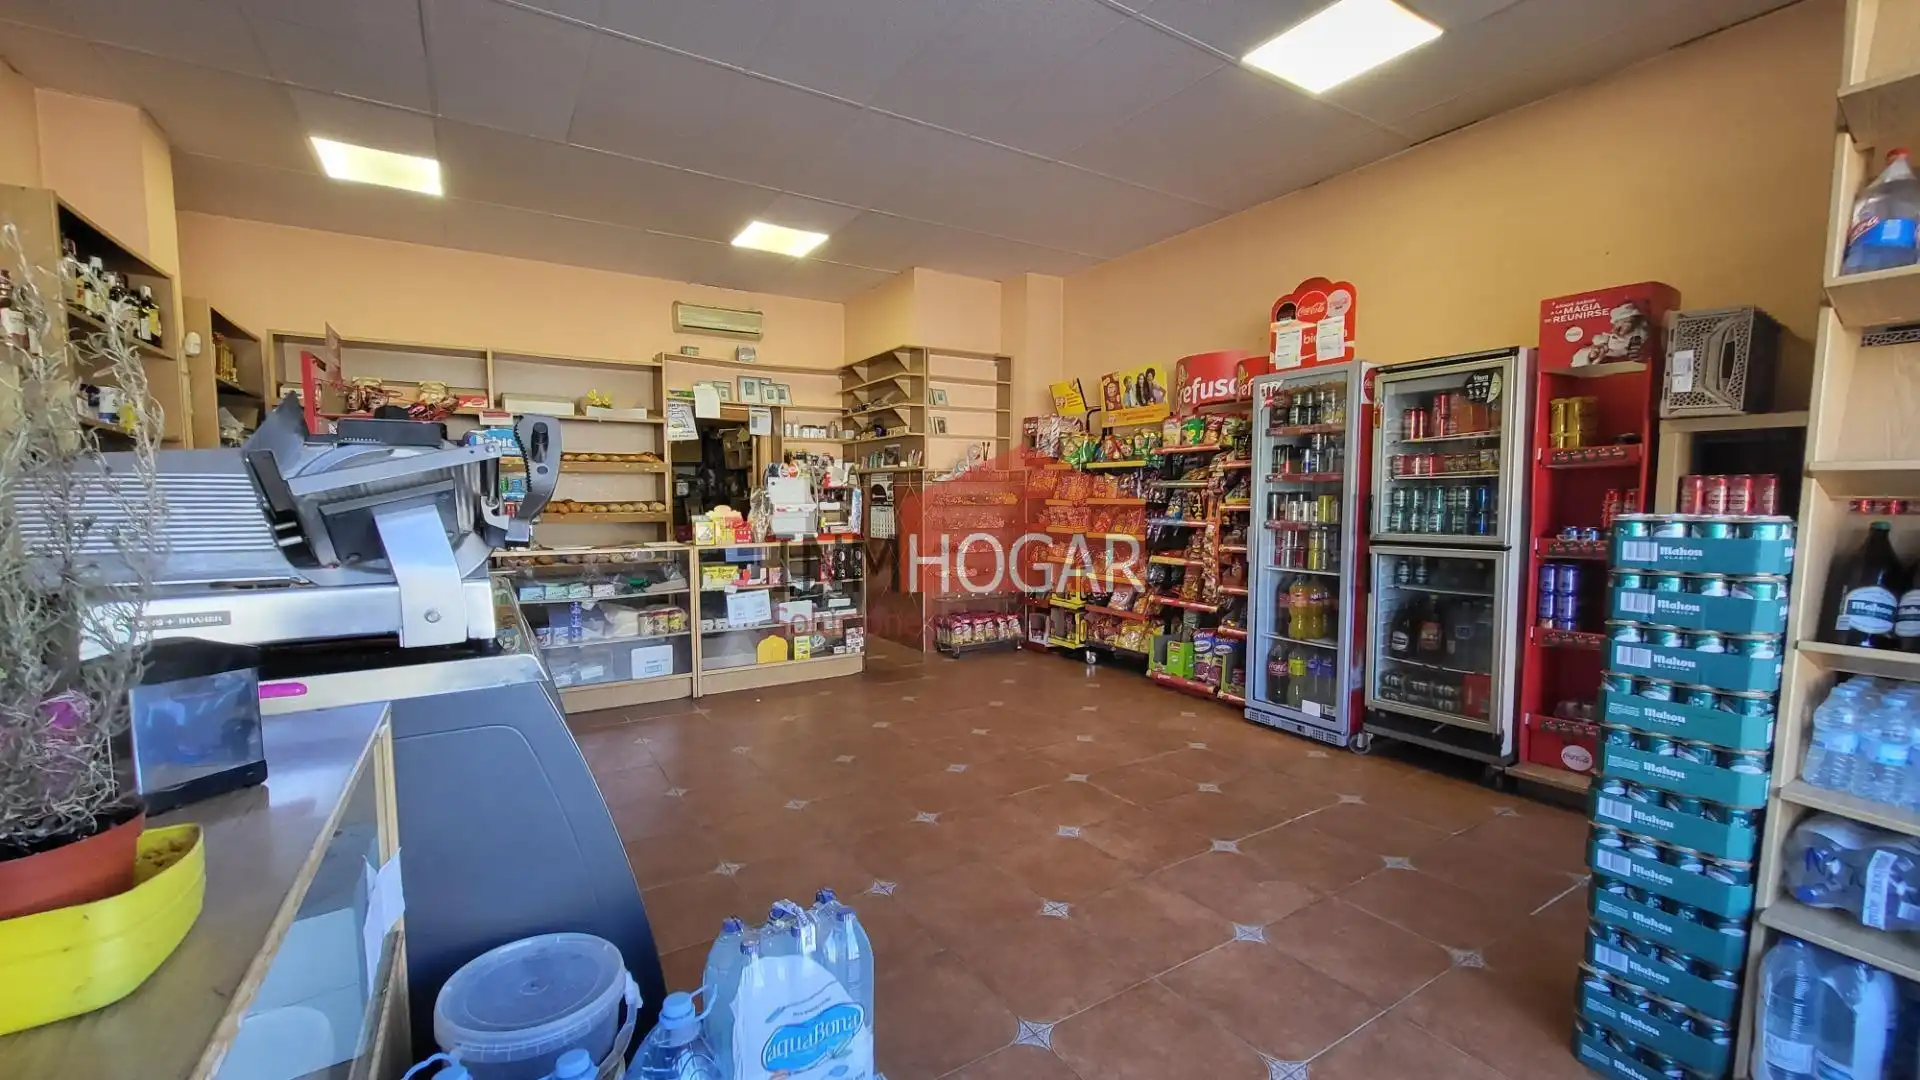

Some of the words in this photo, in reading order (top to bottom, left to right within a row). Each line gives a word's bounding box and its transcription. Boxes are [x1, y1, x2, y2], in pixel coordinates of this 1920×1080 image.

[1553, 308, 1610, 323] REUNIRSE
[1564, 303, 1601, 314] MAGIA
[1659, 546, 1703, 557] Mahou
[1657, 599, 1701, 612] Mahou
[1653, 654, 1696, 668] Mahou
[1644, 707, 1686, 724] Mahou
[1643, 761, 1685, 779] Mahou
[1633, 809, 1675, 829] Mahou
[1632, 863, 1674, 885] Mahou
[1632, 911, 1673, 934] Mahou
[766, 1013, 860, 1062] aquaBona
